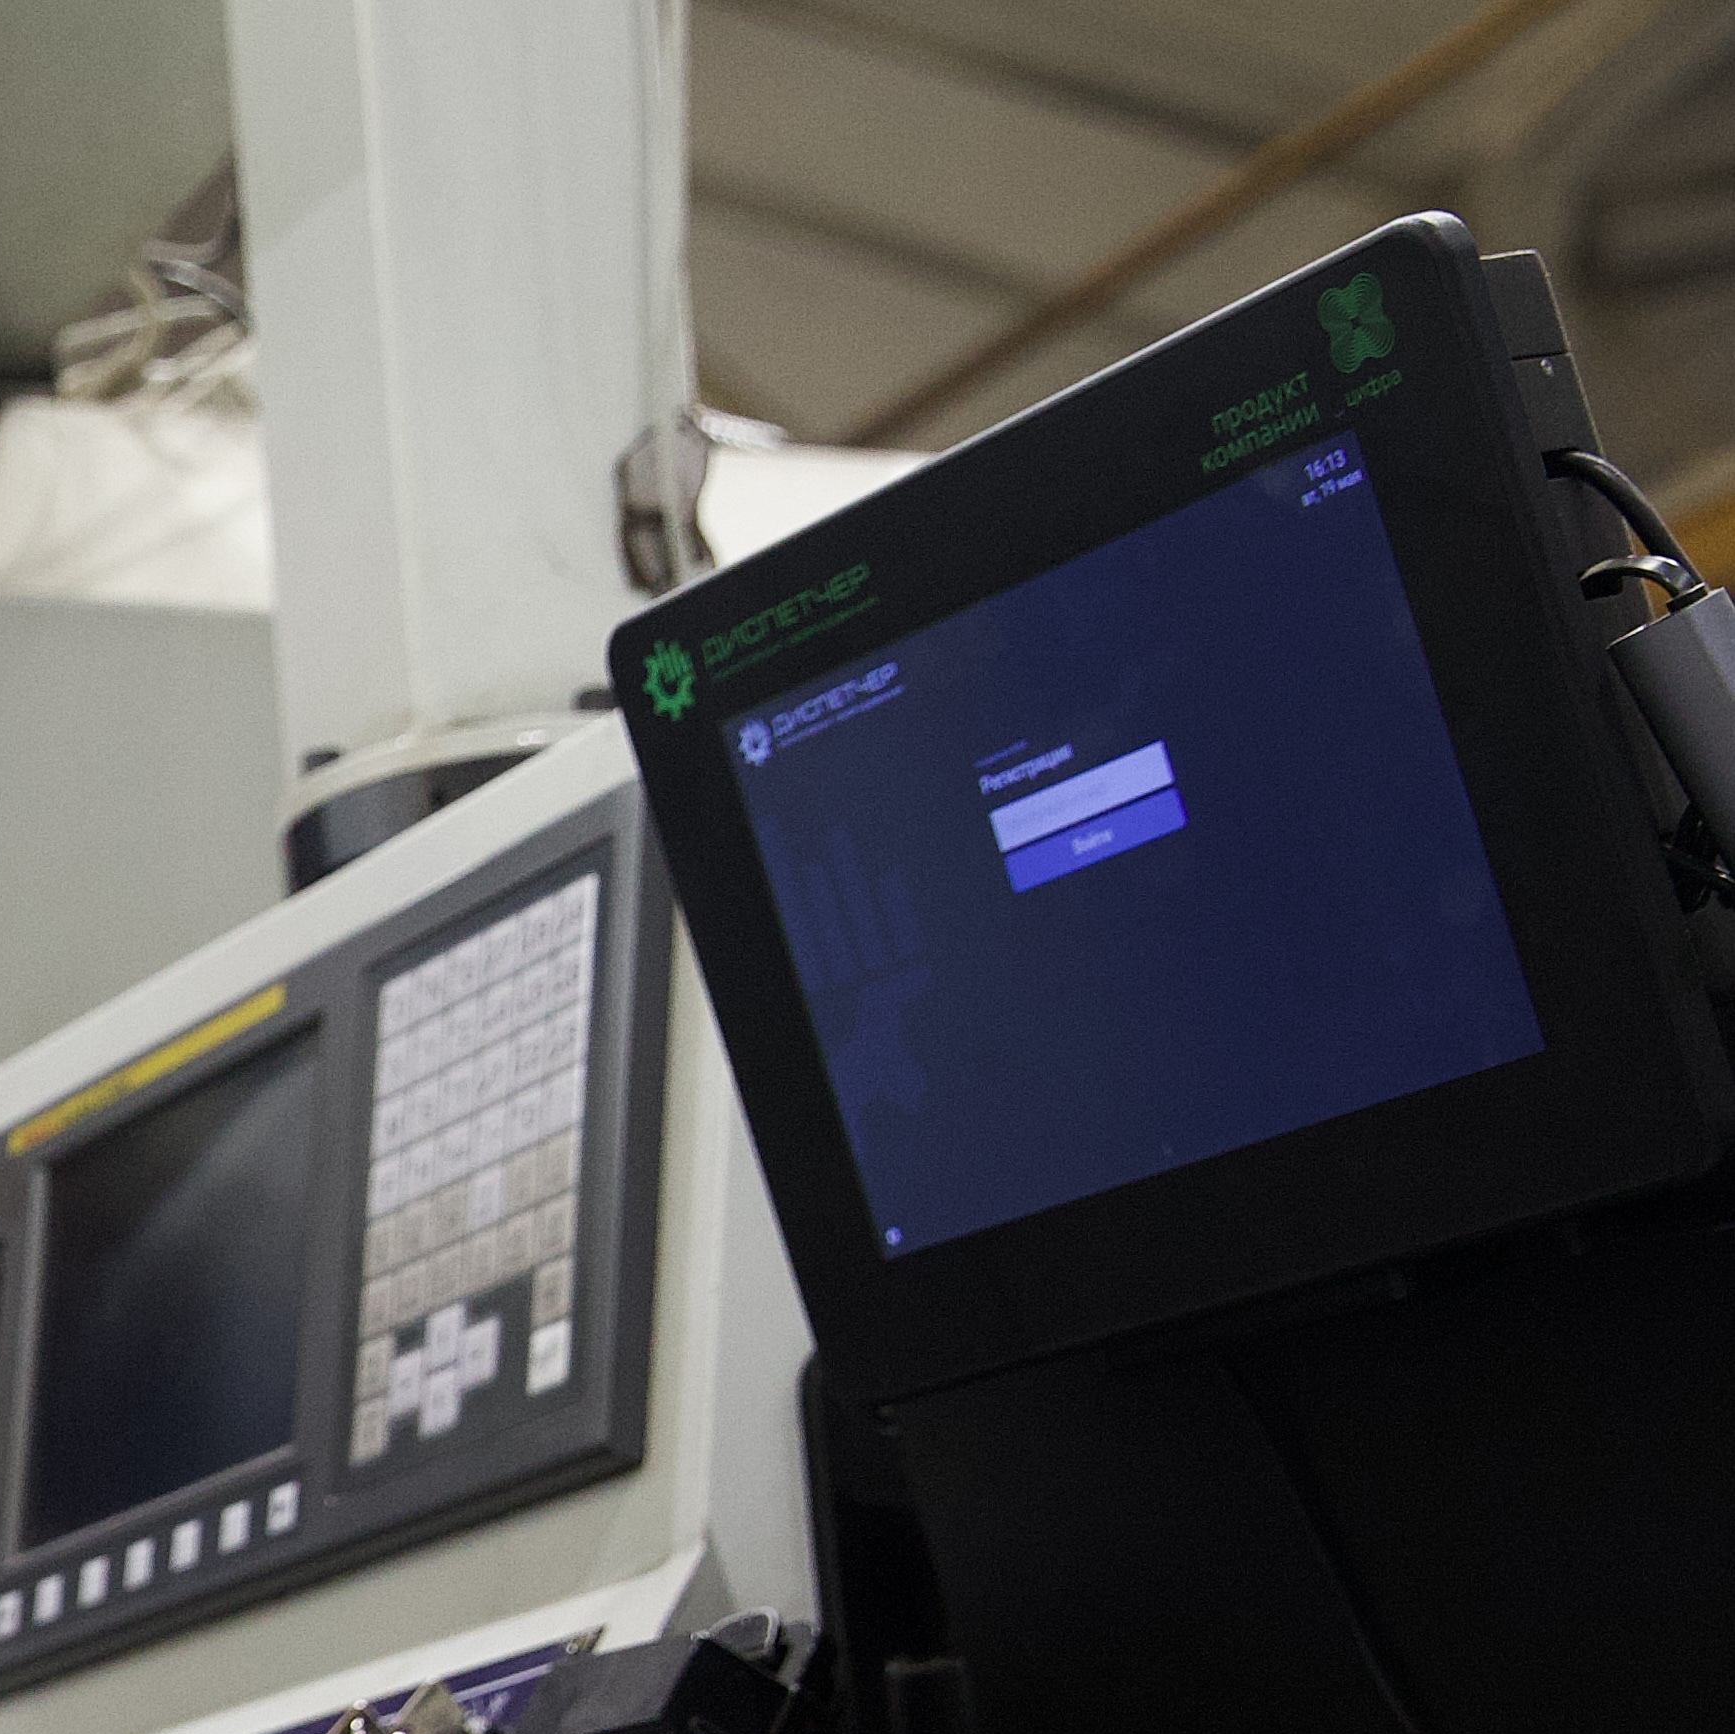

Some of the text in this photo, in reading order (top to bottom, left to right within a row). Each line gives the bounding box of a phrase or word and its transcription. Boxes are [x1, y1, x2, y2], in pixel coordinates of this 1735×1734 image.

[1200, 402, 1321, 473] компании
[1211, 371, 1310, 436] продукт
[701, 561, 871, 669] ДИСПЕТЧЕР
[771, 661, 899, 738] ДИСПЕТЧЕР
[979, 743, 1074, 796] Регистрация
